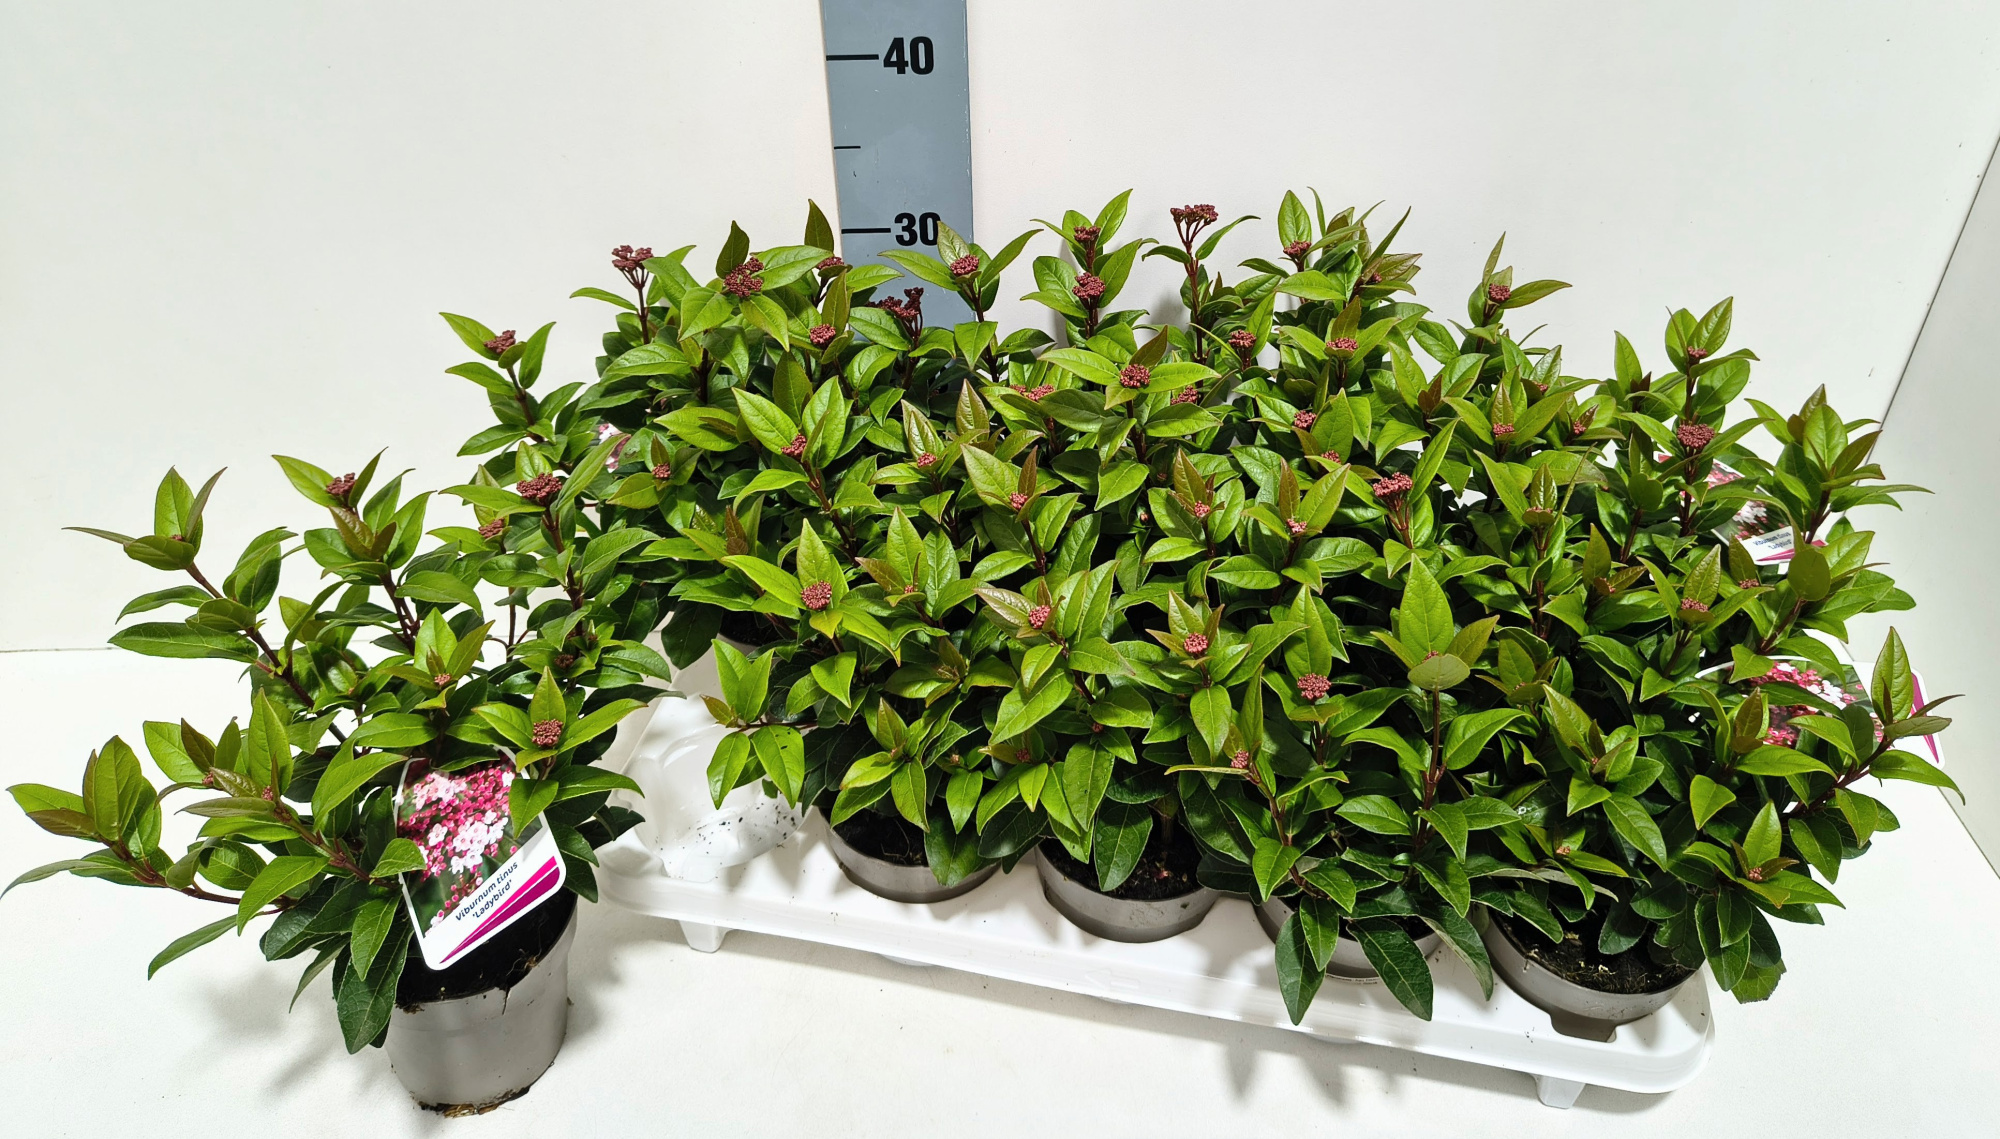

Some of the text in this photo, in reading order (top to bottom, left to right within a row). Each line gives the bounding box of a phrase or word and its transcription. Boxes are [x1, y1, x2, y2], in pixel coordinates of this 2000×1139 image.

[883, 36, 935, 75] 40
[894, 212, 941, 246] 30
[455, 862, 518, 921] Viburnum tinus
[472, 879, 512, 918] 'Ladybird'
